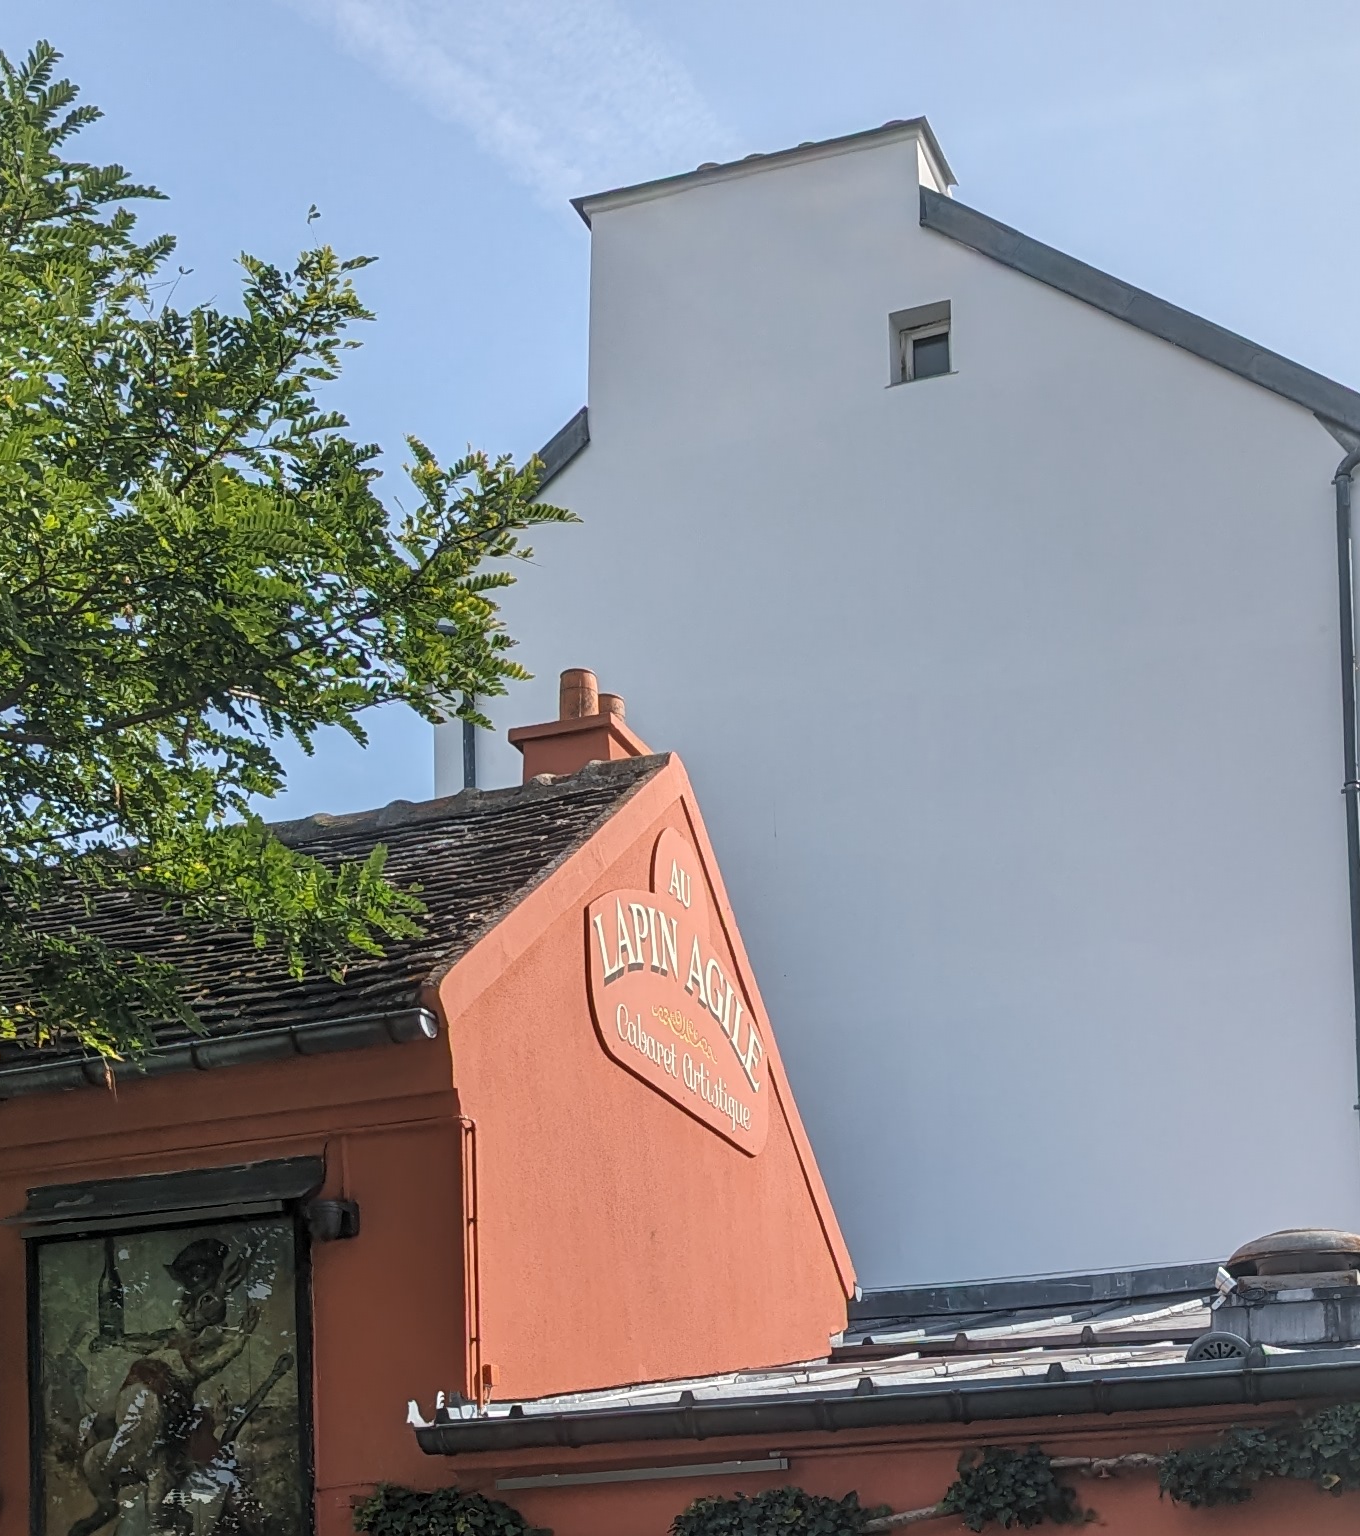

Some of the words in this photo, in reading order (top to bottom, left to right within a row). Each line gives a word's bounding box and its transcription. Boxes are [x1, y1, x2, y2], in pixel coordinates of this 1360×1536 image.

[668, 858, 691, 908] AU
[593, 897, 678, 985] LAPIN
[685, 934, 764, 1092] AGILE
[616, 1003, 679, 1078] Cabaret
[683, 1053, 751, 1131] Artistique
